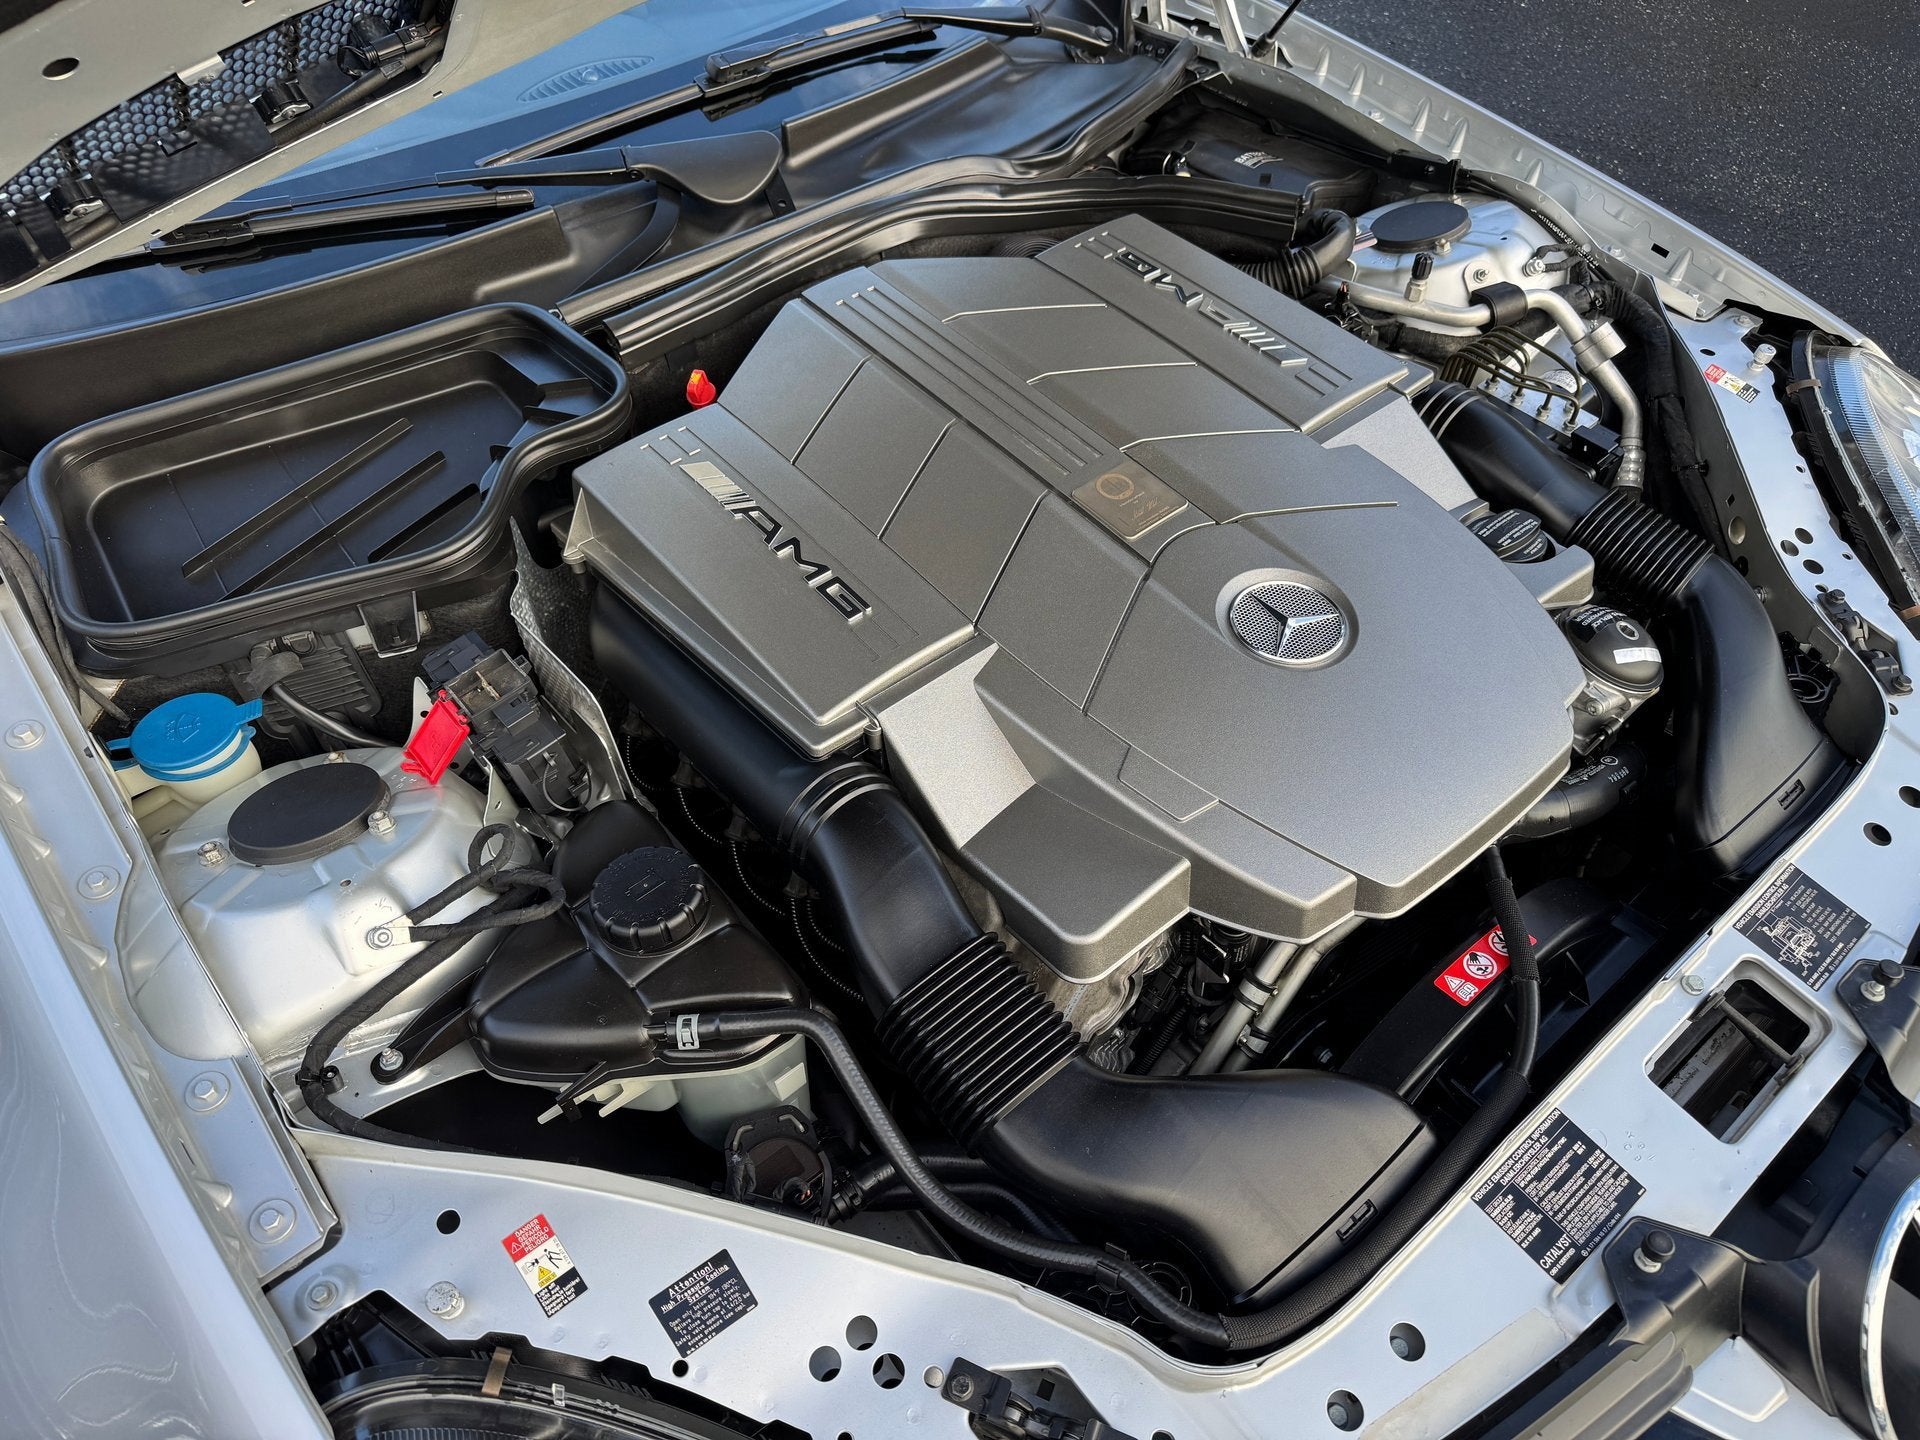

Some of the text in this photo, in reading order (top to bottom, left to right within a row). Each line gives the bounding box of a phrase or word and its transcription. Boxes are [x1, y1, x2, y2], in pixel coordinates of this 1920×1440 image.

[1112, 250, 1250, 328] AMG
[730, 505, 872, 624] AMG
[1472, 1179, 1494, 1202] VEHICLE
[1490, 1157, 1515, 1182] EMISSION
[1510, 1136, 1534, 1161] CONTROL
[1530, 1108, 1561, 1140] INFORMATION
[1499, 1141, 1542, 1185] DAIMLERCHRYSLER
[1538, 1134, 1548, 1144] AG
[514, 1218, 539, 1237] DANGER
[517, 1224, 541, 1243] GEFAHR
[520, 1225, 549, 1248] PERICOLO
[523, 1233, 549, 1253] PELIGRO
[1538, 1233, 1573, 1270] CATALYST
[536, 1287, 548, 1298] Light
[660, 1261, 728, 1313] High Pressure Cooling
[666, 1260, 713, 1297] Attention!
[686, 1283, 711, 1304] System
[668, 1316, 681, 1328] Open
[680, 1308, 692, 1319] only
[692, 1297, 708, 1311] below
[673, 1283, 740, 1333] Relieve high pressure slowly.
[674, 1332, 692, 1347] Safety
[690, 1322, 706, 1336] valve
[705, 1312, 720, 1326] opens
[719, 1307, 727, 1316] at
[741, 1290, 751, 1300] bar
[679, 1290, 741, 1336] To close turn cap to stop.
[687, 1332, 703, 1346] excess
[703, 1318, 723, 1335] pressure
[723, 1310, 734, 1321] (see
